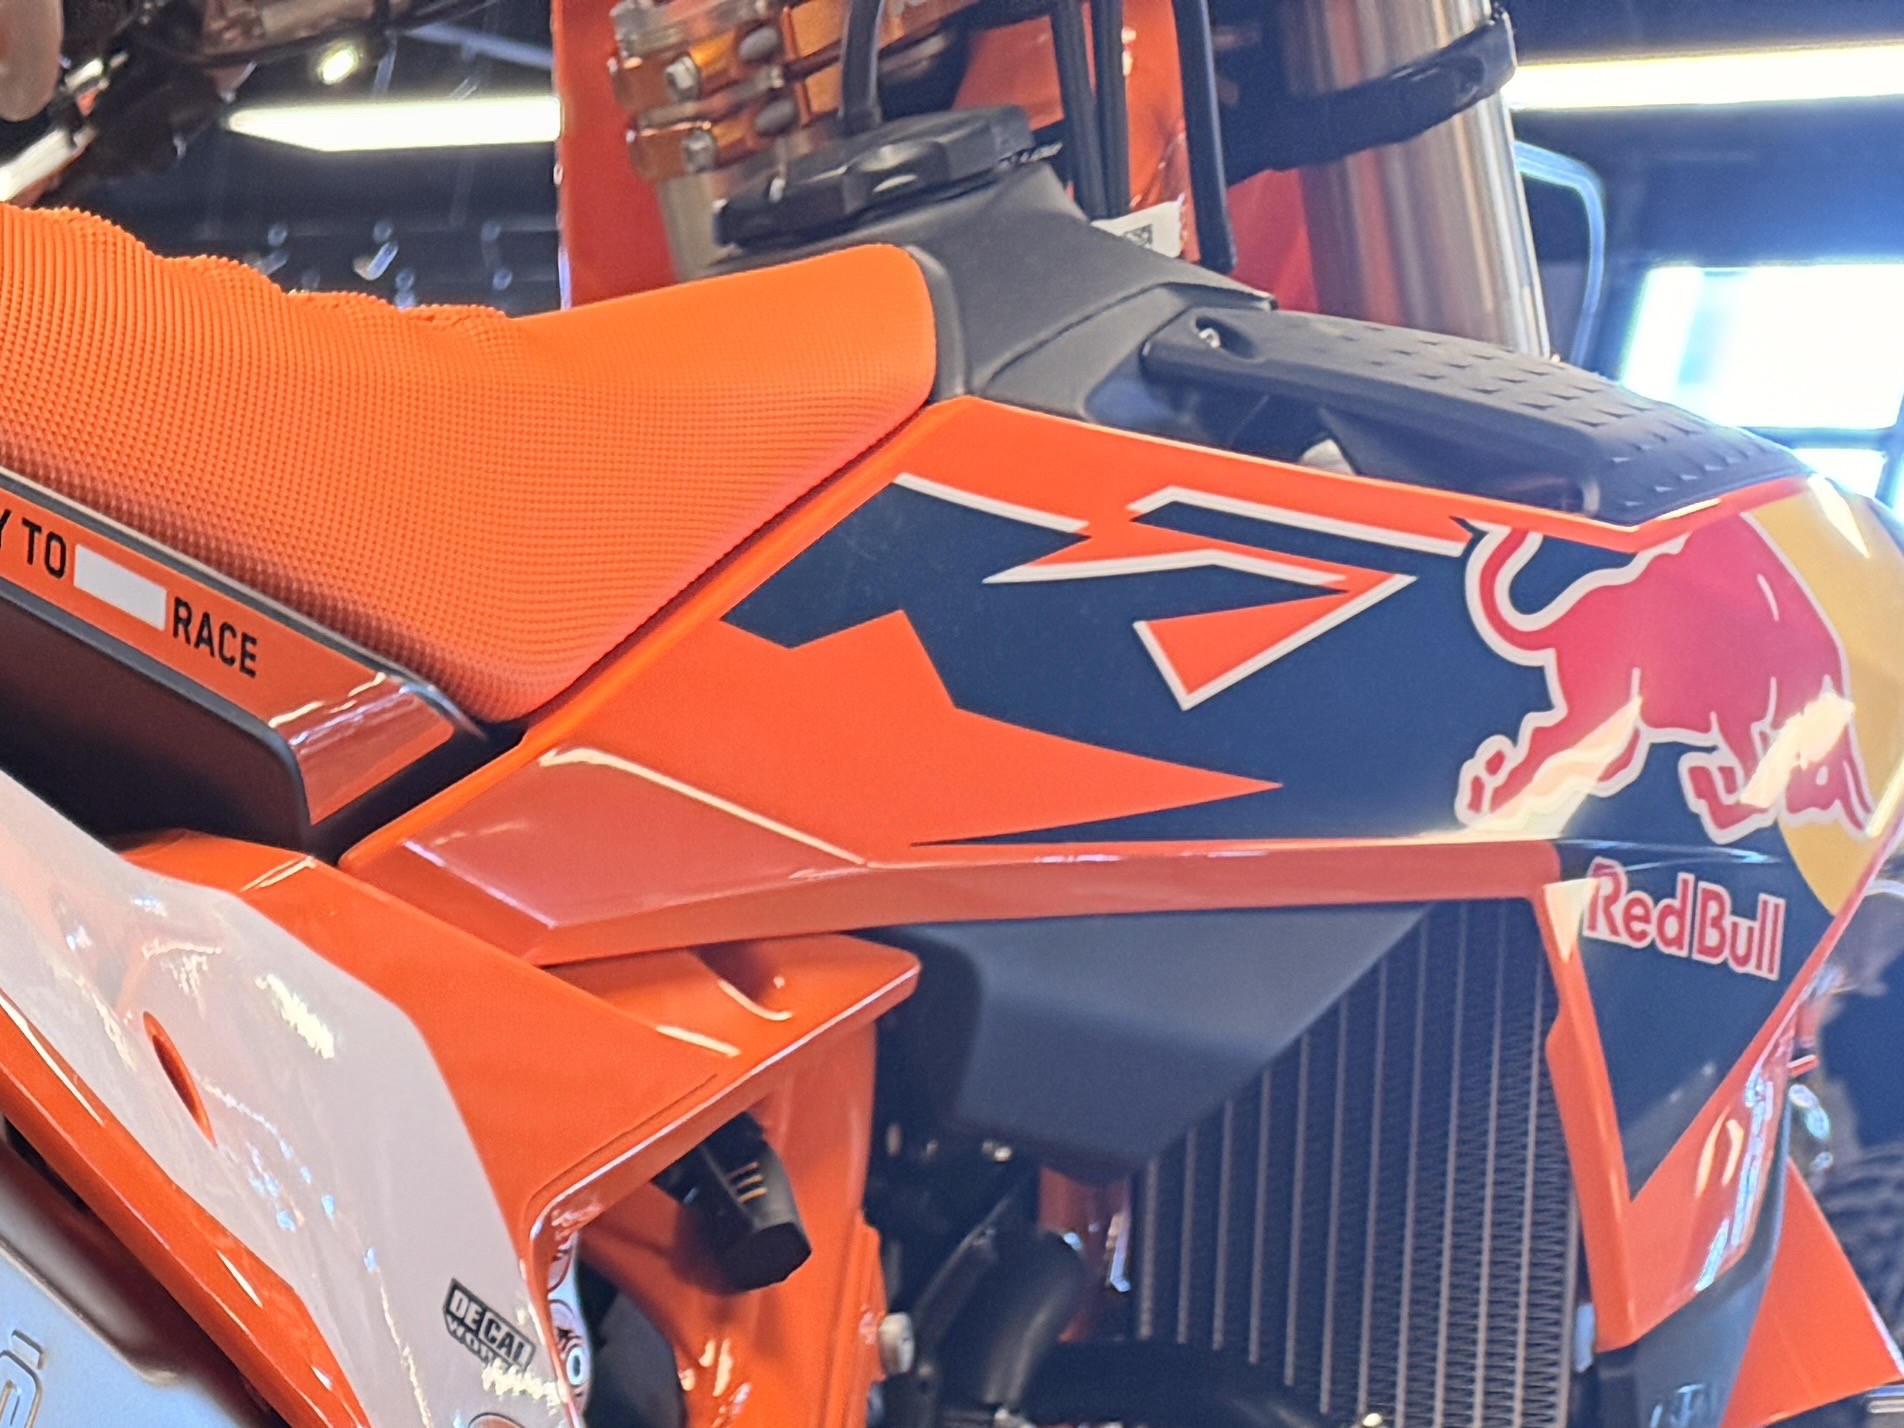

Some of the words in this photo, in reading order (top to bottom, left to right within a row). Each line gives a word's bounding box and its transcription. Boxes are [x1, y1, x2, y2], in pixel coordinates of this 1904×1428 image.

[21, 517, 68, 579] TO
[171, 596, 258, 679] RACE
[448, 1288, 535, 1369] DECAL
